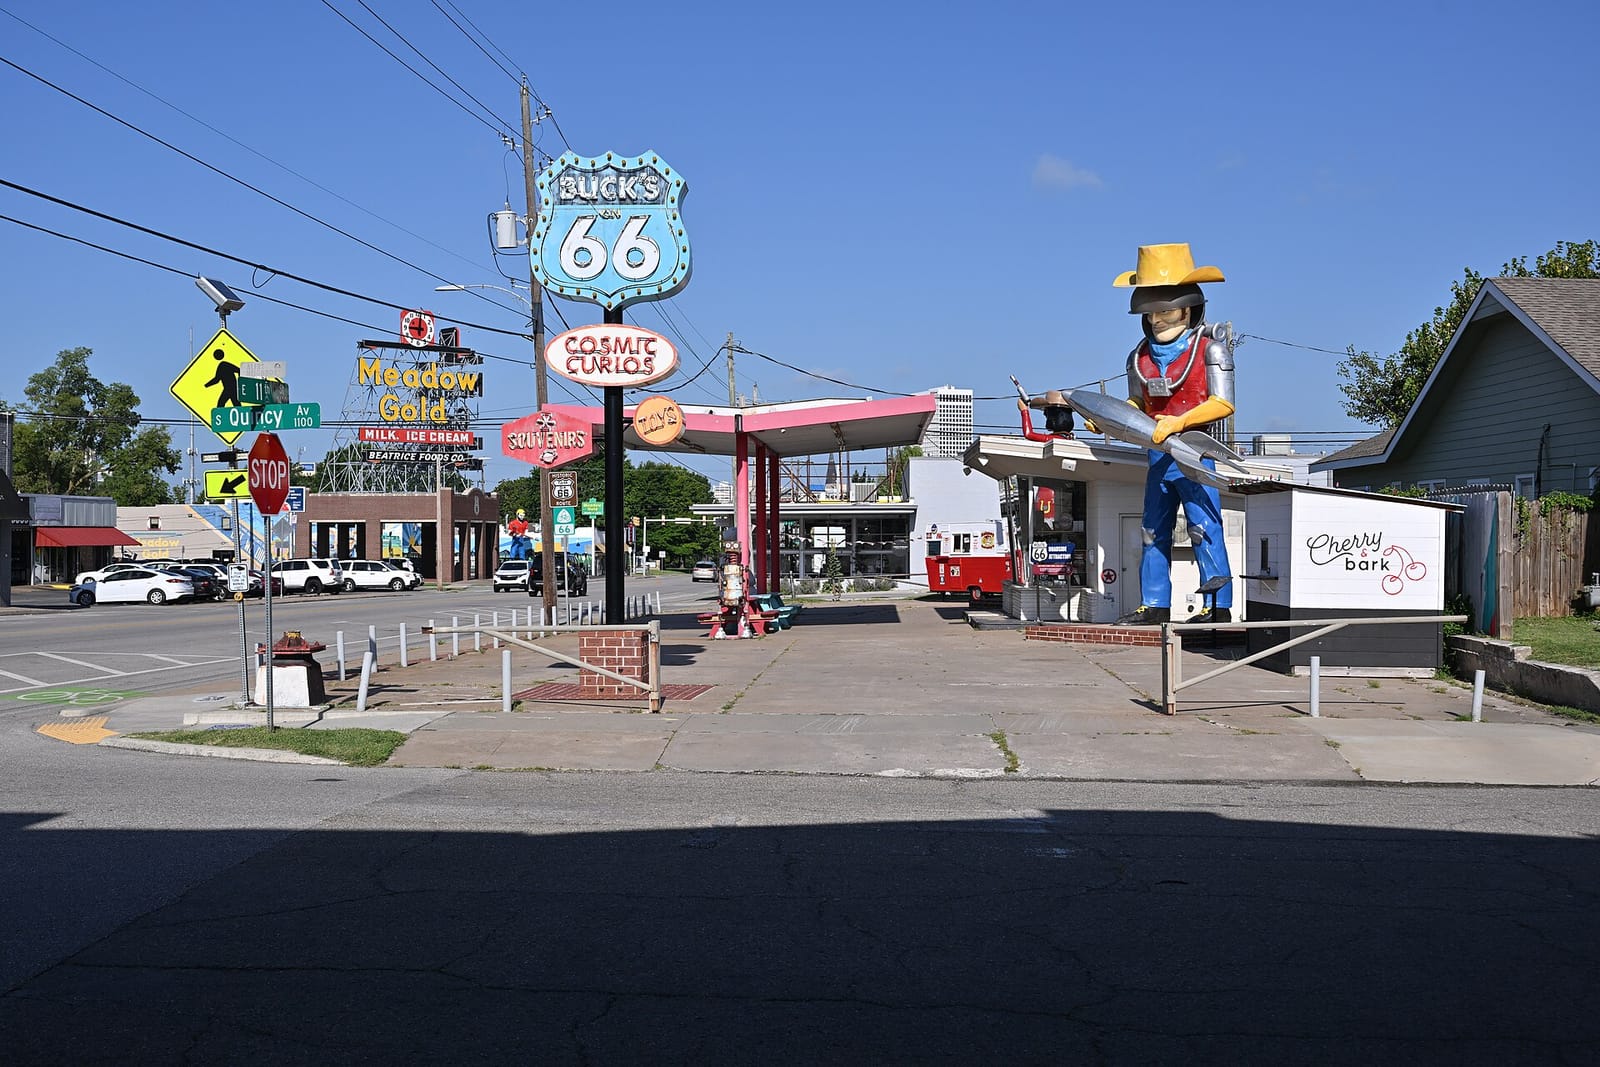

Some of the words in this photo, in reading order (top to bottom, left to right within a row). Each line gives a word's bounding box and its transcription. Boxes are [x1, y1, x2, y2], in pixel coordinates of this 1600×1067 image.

[559, 175, 660, 201] BUCK'S
[559, 214, 661, 282] 66
[564, 335, 658, 355] COSMIC
[358, 357, 477, 392] Meadow
[566, 355, 656, 375] CURIOS
[242, 384, 246, 396] E
[216, 414, 222, 426] S
[296, 404, 310, 416] Av
[379, 393, 448, 423] Gold
[294, 417, 313, 427] 1100
[406, 431, 426, 442] ICE
[430, 432, 469, 443] CREAM
[507, 430, 588, 451] SOUVENIRS
[368, 451, 416, 461] BEATRICE
[418, 452, 449, 462] FOODS
[251, 459, 286, 490] STOP
[558, 490, 570, 498] 66
[558, 525, 571, 534] 66
[1034, 549, 1046, 560] 66
[1307, 531, 1383, 566] Cherry
[1360, 548, 1368, 558] &
[1346, 558, 1390, 571] bark
